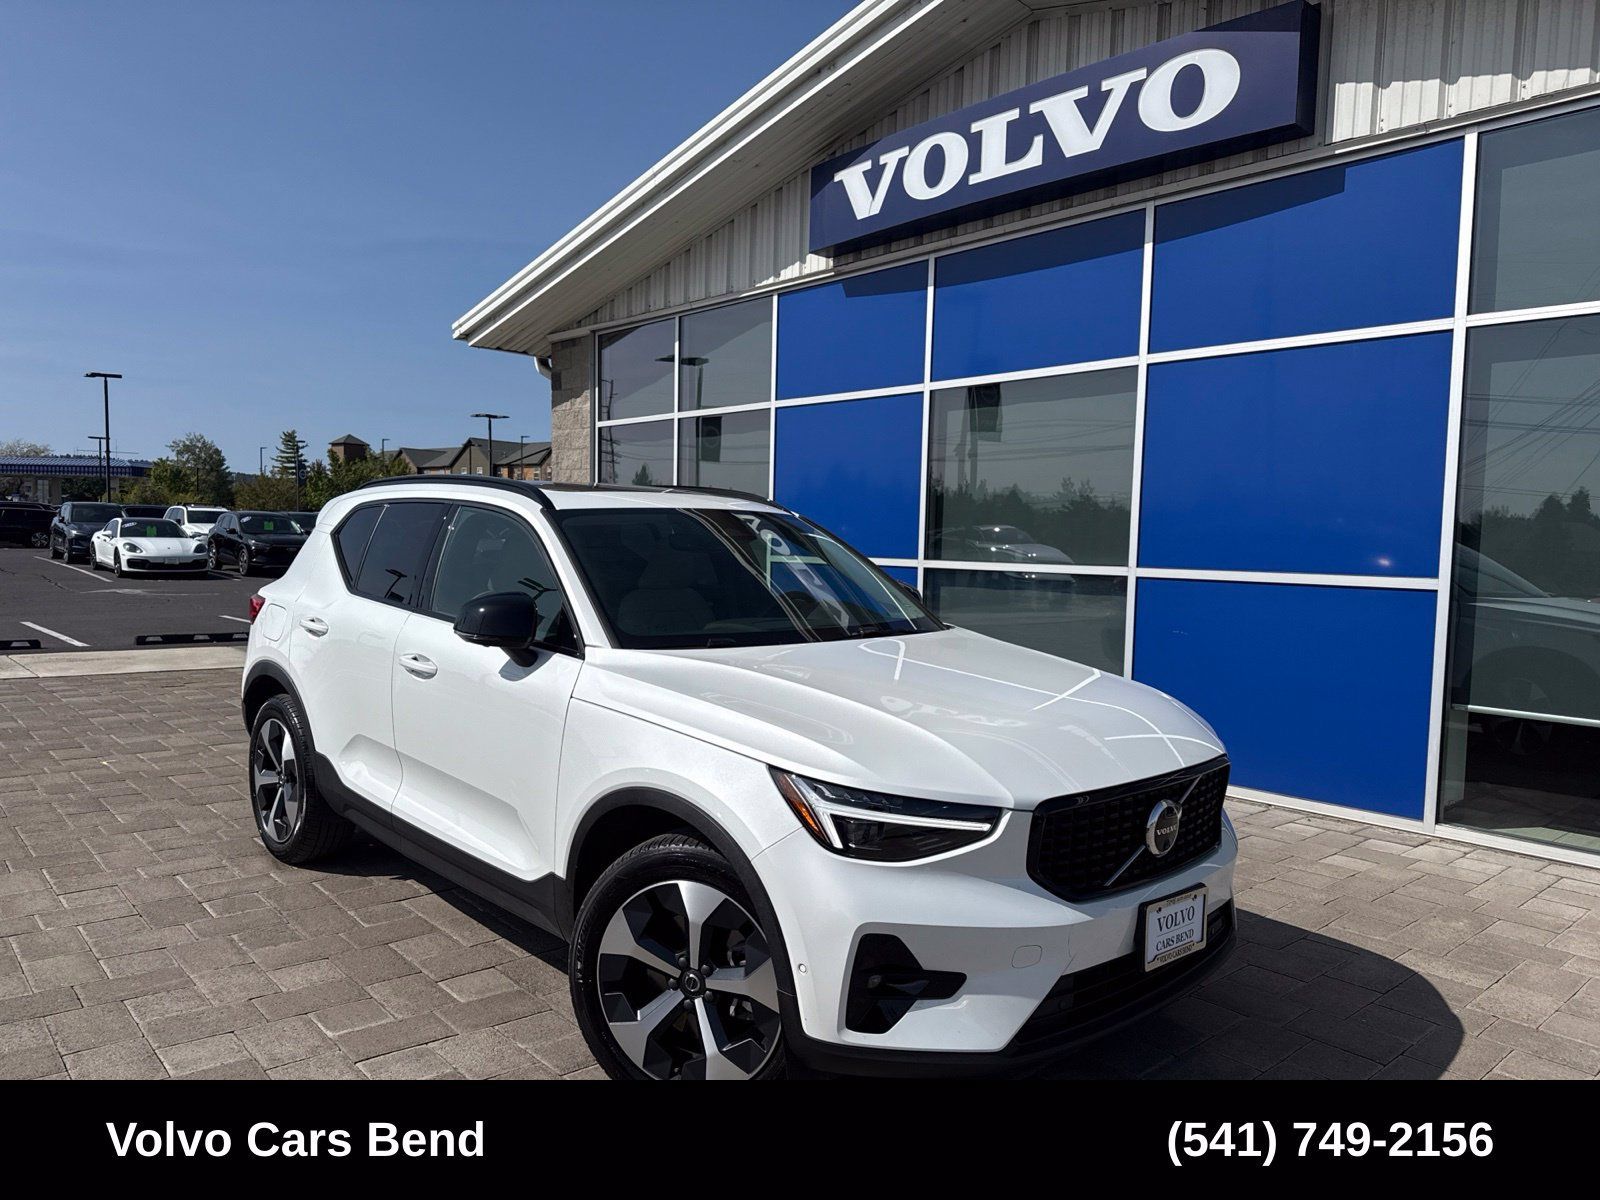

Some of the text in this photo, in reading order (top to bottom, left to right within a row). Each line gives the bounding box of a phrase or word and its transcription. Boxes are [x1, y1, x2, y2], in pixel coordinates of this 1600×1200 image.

[834, 48, 1241, 220] VOLVO
[1157, 906, 1195, 932] VOLVO
[1156, 929, 1194, 951] CARS BEND
